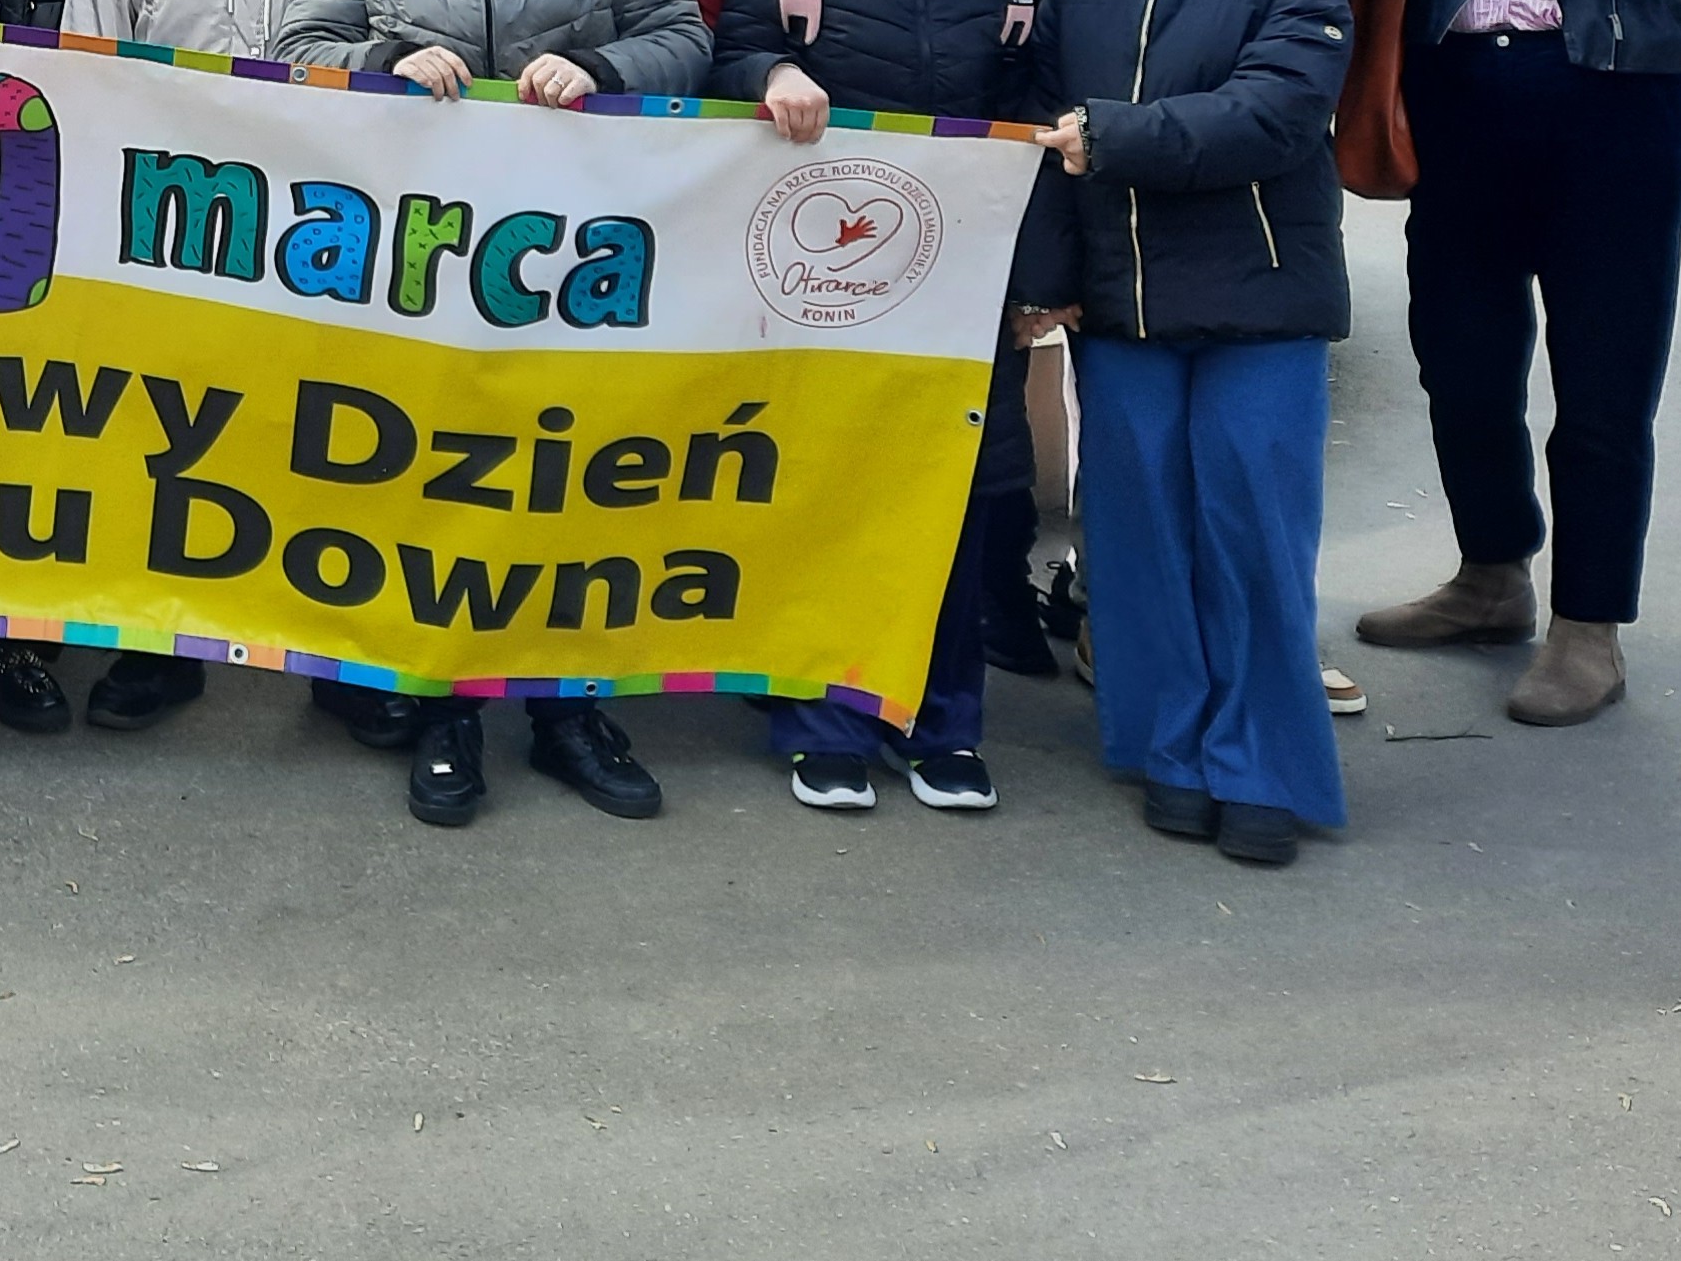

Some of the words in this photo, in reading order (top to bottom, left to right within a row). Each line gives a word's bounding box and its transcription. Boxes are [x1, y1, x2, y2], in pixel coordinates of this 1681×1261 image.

[119, 146, 657, 330] marca
[752, 209, 773, 279] FUNDACJA
[766, 189, 787, 208] NA
[785, 168, 828, 191] RZECZ
[831, 164, 902, 185] ROZWOJU
[781, 261, 891, 296] Otwarcie
[801, 308, 856, 322] KONIN
[289, 378, 781, 514] Dzień
[146, 475, 742, 633] Downa
